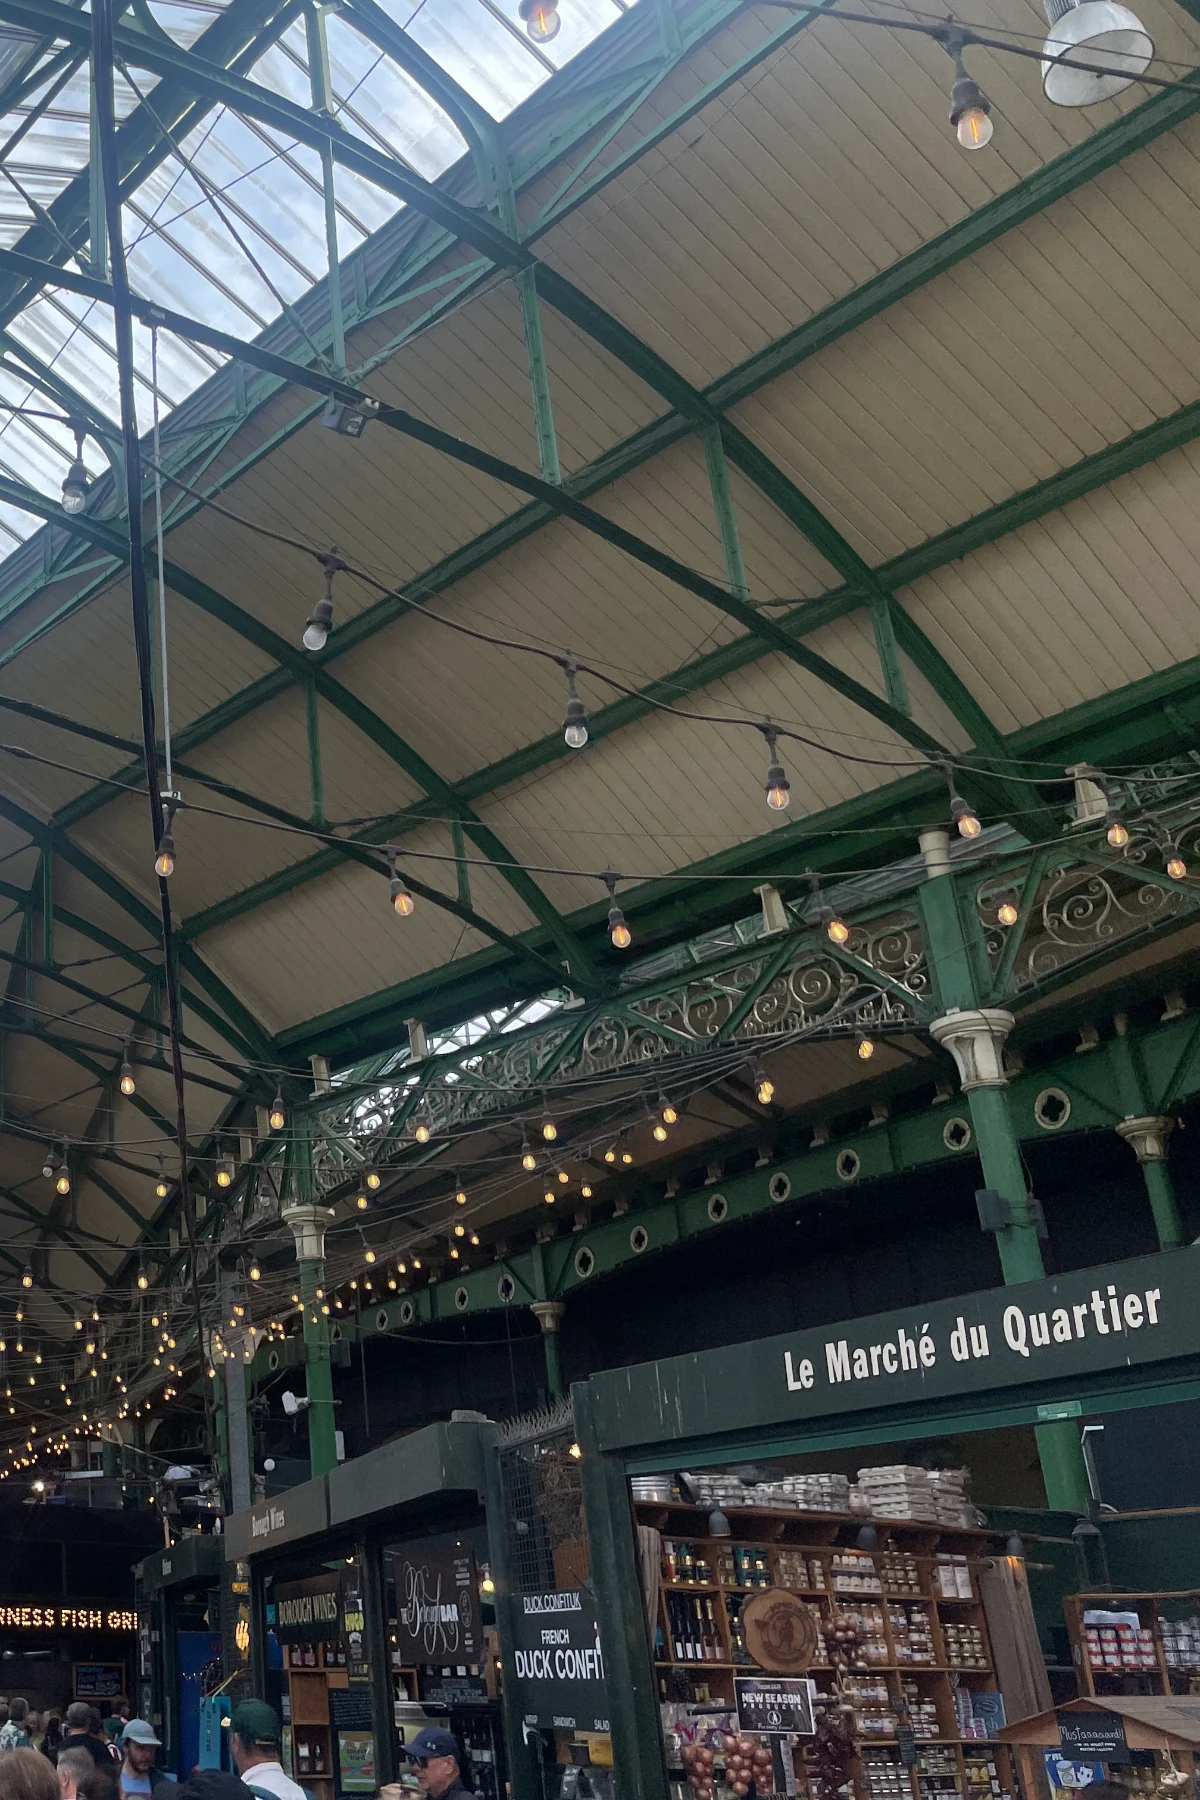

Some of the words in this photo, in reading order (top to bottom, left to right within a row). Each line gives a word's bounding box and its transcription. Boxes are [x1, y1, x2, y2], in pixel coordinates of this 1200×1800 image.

[784, 1351, 814, 1391] Le
[825, 1323, 936, 1384] Marché
[950, 1317, 990, 1361] du
[1003, 1285, 1161, 1357] Quartier
[252, 1509, 270, 1537] Borough
[270, 1507, 285, 1531] Wines
[278, 1596, 312, 1627] BOROUGH
[313, 1592, 338, 1622] WINES
[440, 1604, 459, 1622] BAR
[523, 1594, 543, 1613] DUCK
[61, 1609, 101, 1628] FISH
[541, 1629, 570, 1645] FRENCH
[514, 1650, 554, 1679] DUCK
[555, 1649, 605, 1680] CONFIT
[741, 1692, 764, 1703] NEW
[765, 1693, 802, 1704] SEASON
[552, 1716, 576, 1728] SANDWICH
[593, 1719, 610, 1731] SALAD
